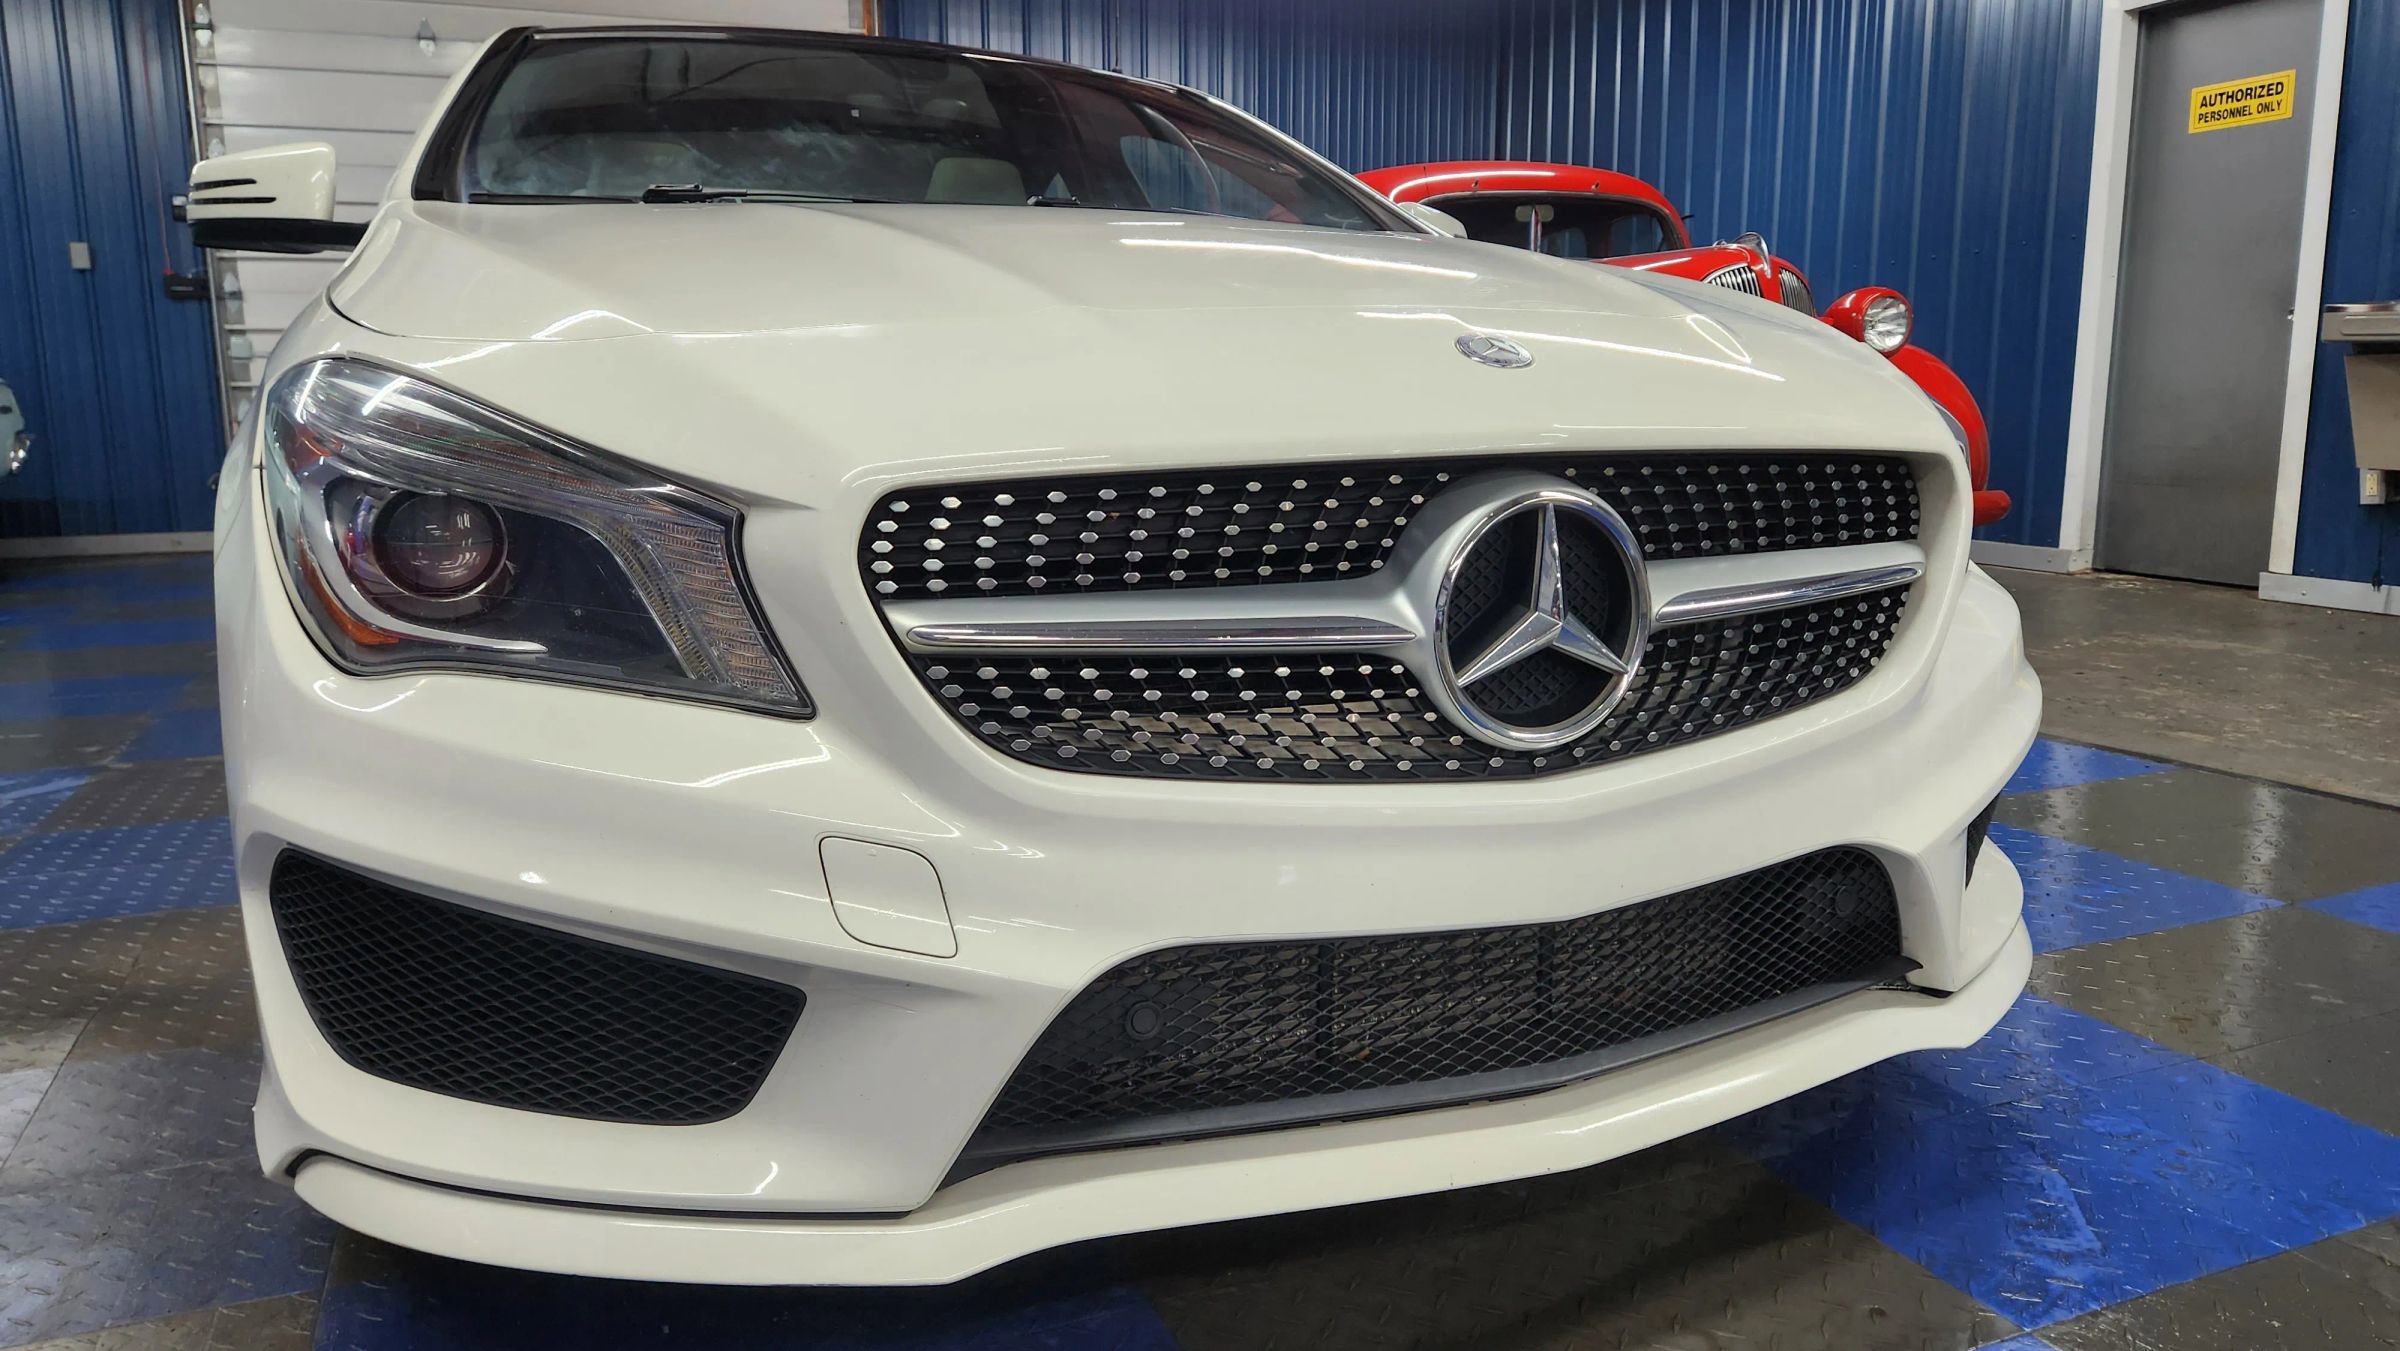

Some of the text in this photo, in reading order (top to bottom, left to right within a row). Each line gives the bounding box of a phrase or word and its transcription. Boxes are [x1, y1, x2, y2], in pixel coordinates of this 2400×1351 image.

[2200, 82, 2284, 108] AUTHORIZED
[2198, 99, 2282, 124] PERSONNEL ONLY
